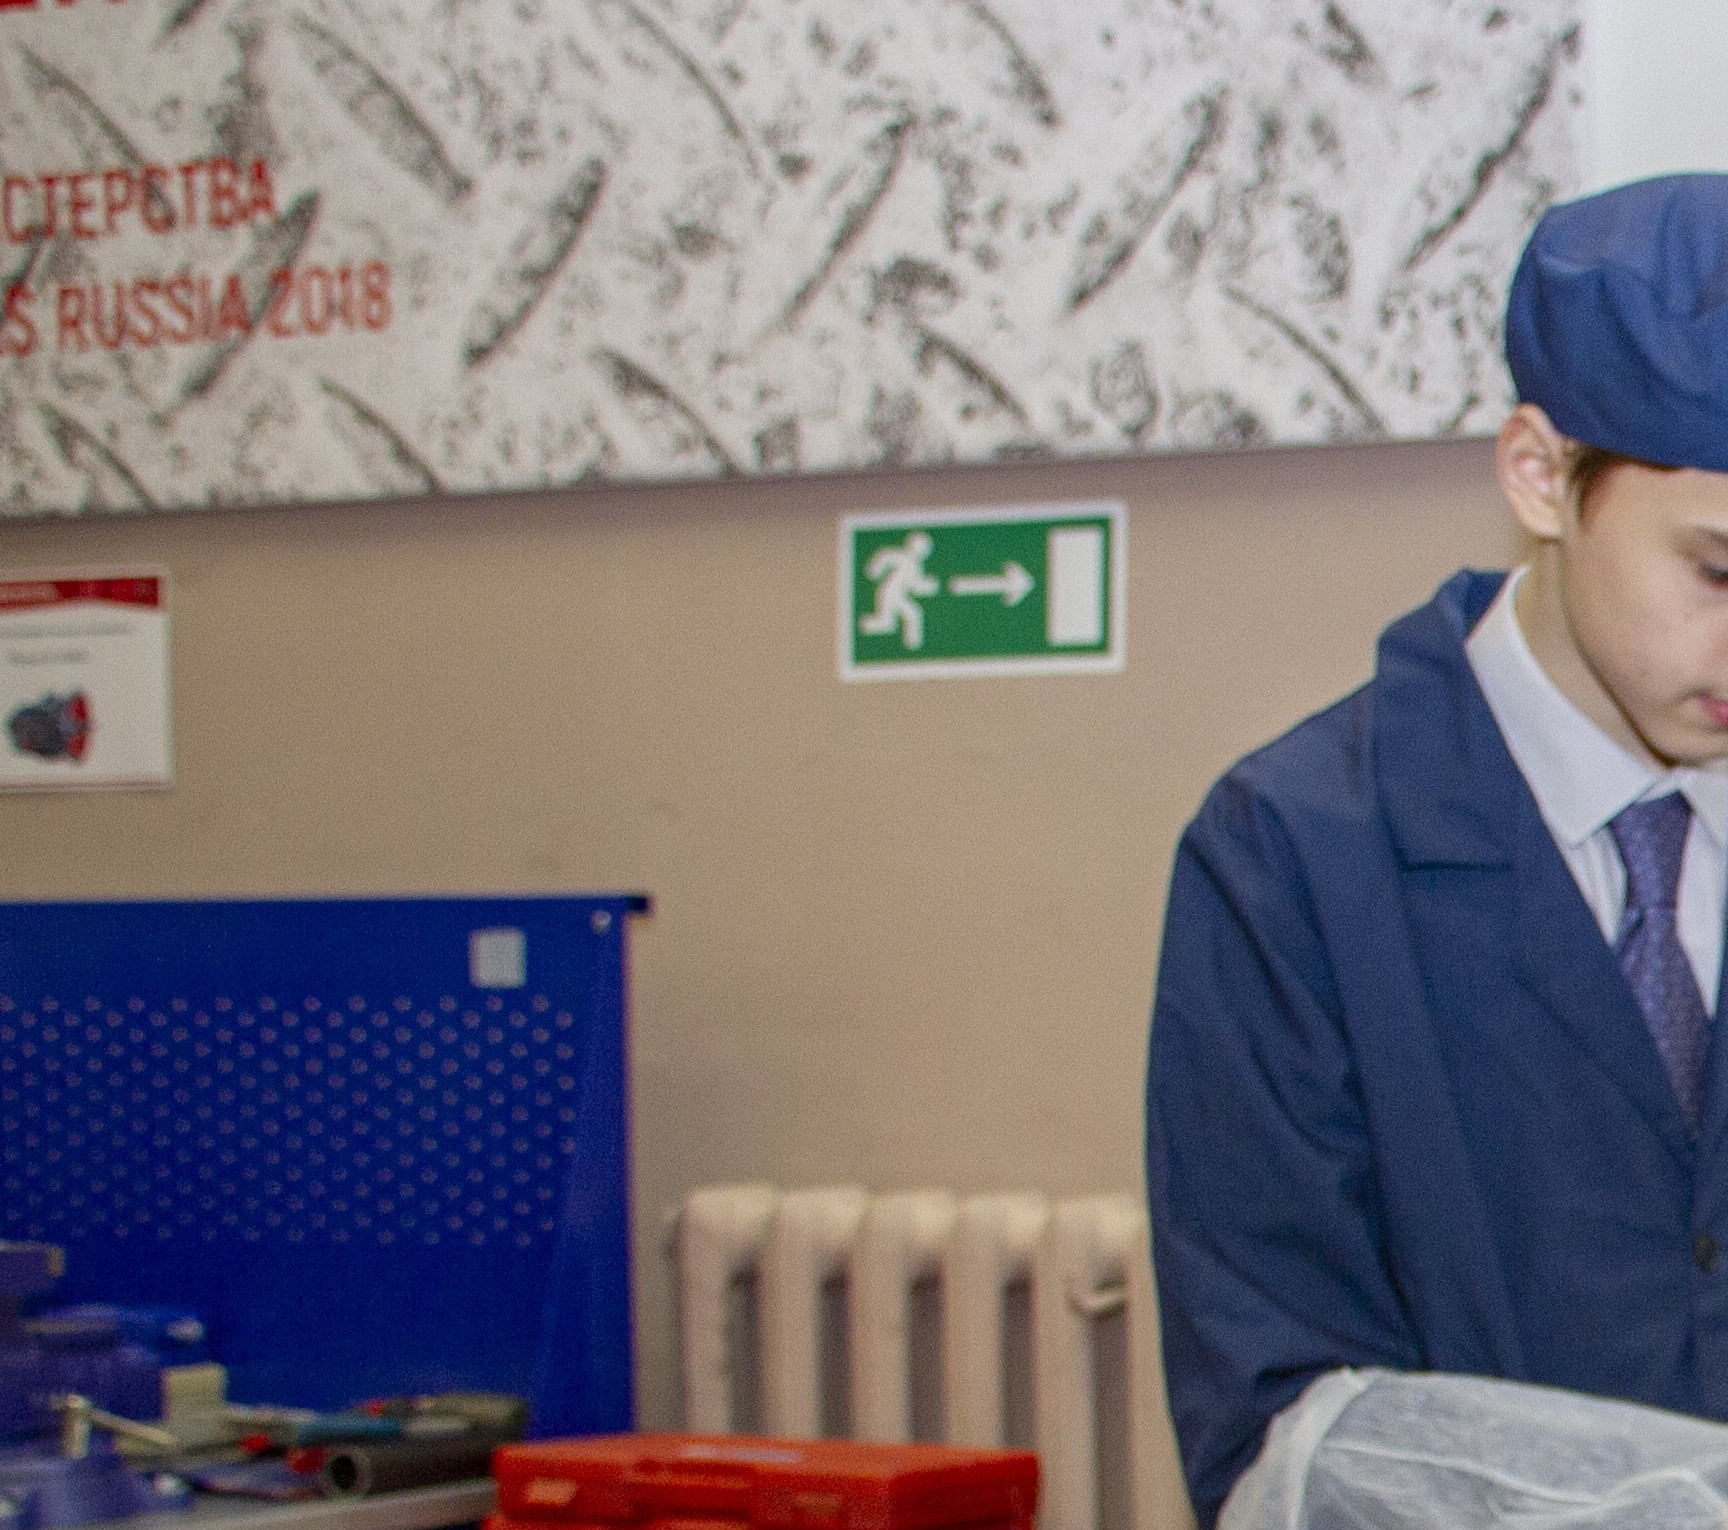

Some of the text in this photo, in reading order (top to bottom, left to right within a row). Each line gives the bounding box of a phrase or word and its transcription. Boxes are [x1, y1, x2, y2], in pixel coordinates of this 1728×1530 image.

[3, 157, 276, 243] СТЕРСТВА
[0, 259, 393, 356] S RUSSIA 2018
